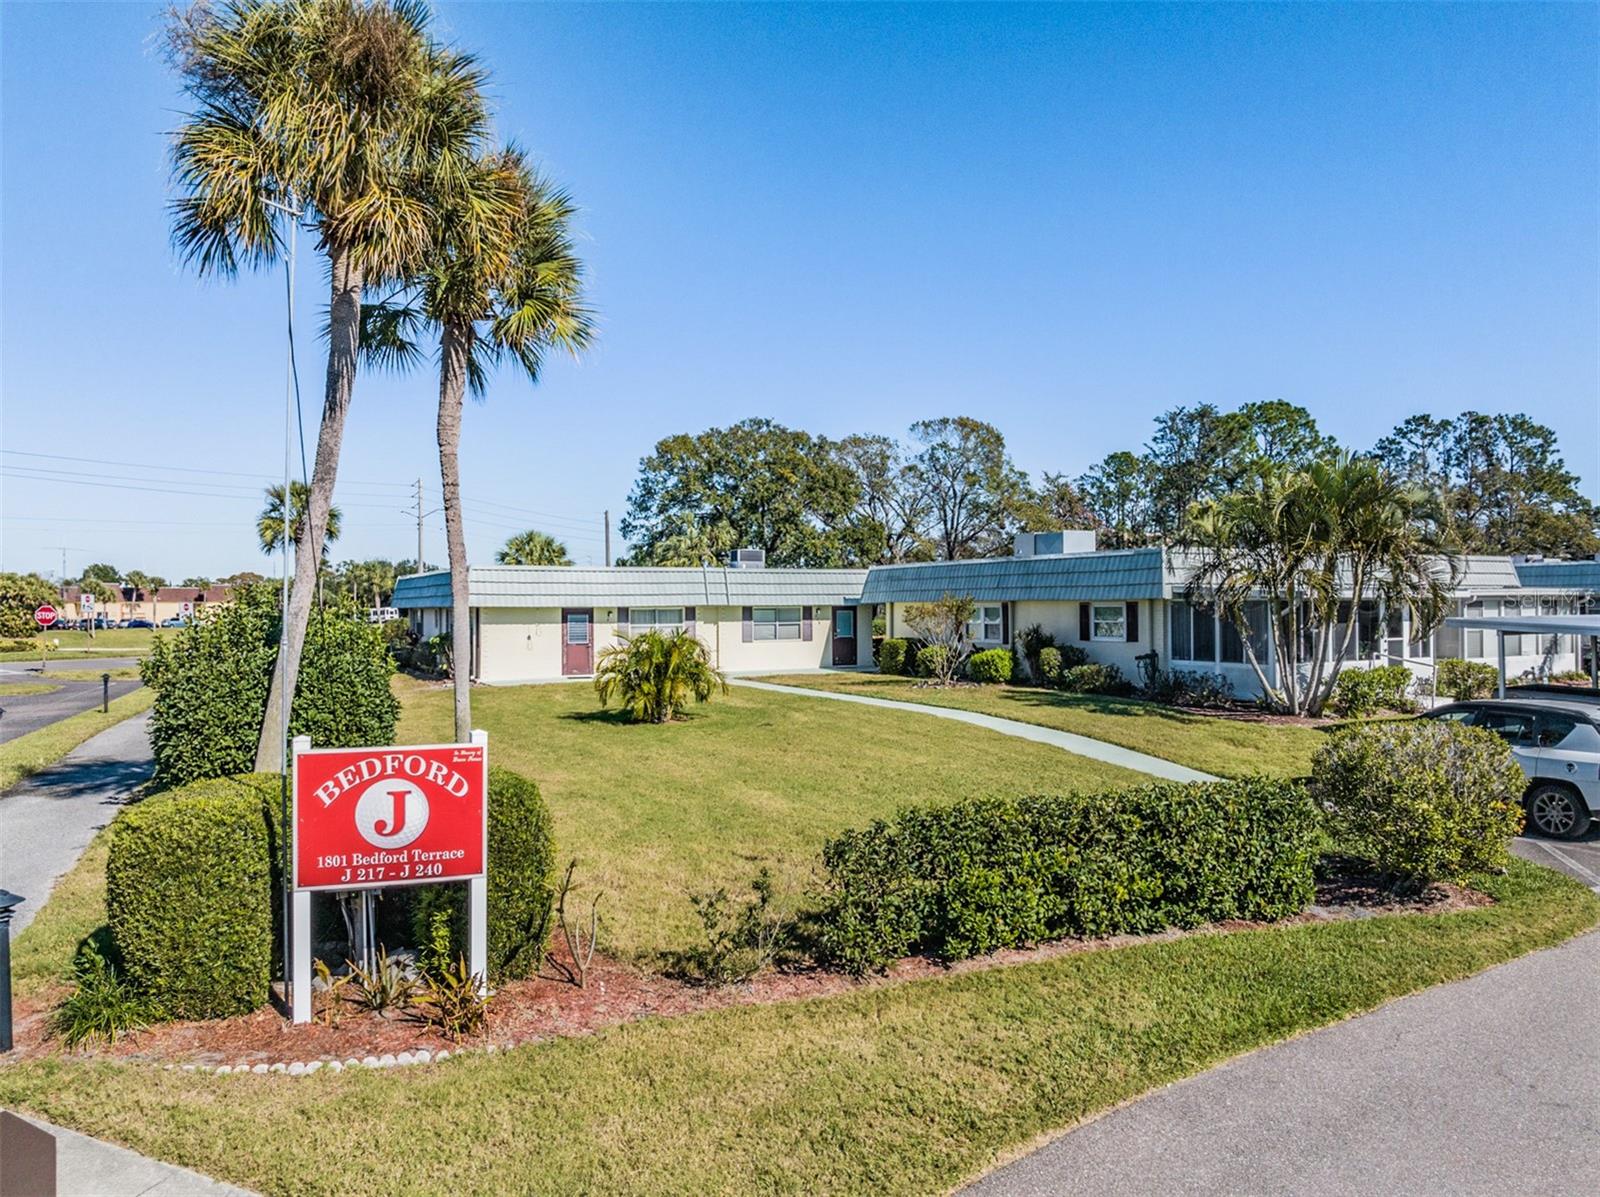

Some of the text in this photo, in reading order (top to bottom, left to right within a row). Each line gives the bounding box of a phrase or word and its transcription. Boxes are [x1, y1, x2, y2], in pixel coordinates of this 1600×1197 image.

[37, 611, 56, 620] STOP
[313, 754, 469, 808] BEDFORD
[374, 790, 412, 837] J
[318, 849, 465, 868] 1801 Bedford Terrace
[341, 869, 353, 882] J
[357, 867, 385, 881] 217
[400, 864, 411, 878] J
[415, 863, 443, 877] 240
